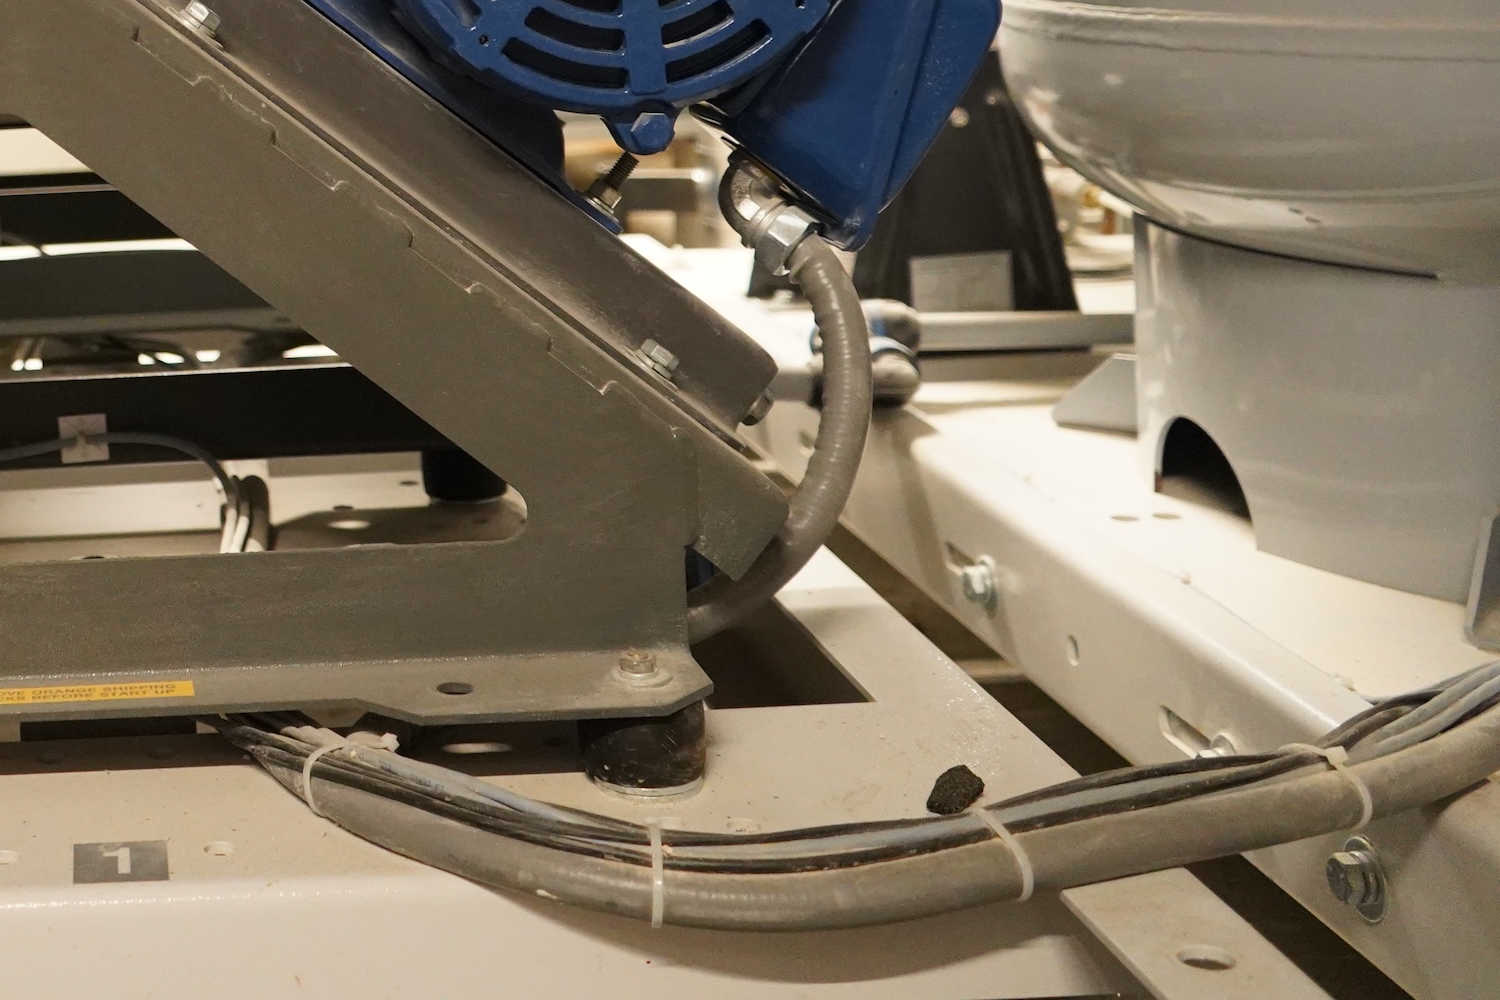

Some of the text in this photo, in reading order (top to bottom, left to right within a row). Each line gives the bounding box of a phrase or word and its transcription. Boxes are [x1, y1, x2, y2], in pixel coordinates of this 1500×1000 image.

[32, 687, 97, 695] ORANGE
[103, 683, 177, 692] SHIPPING
[32, 692, 94, 700] BEFORE
[102, 846, 132, 875] 1
